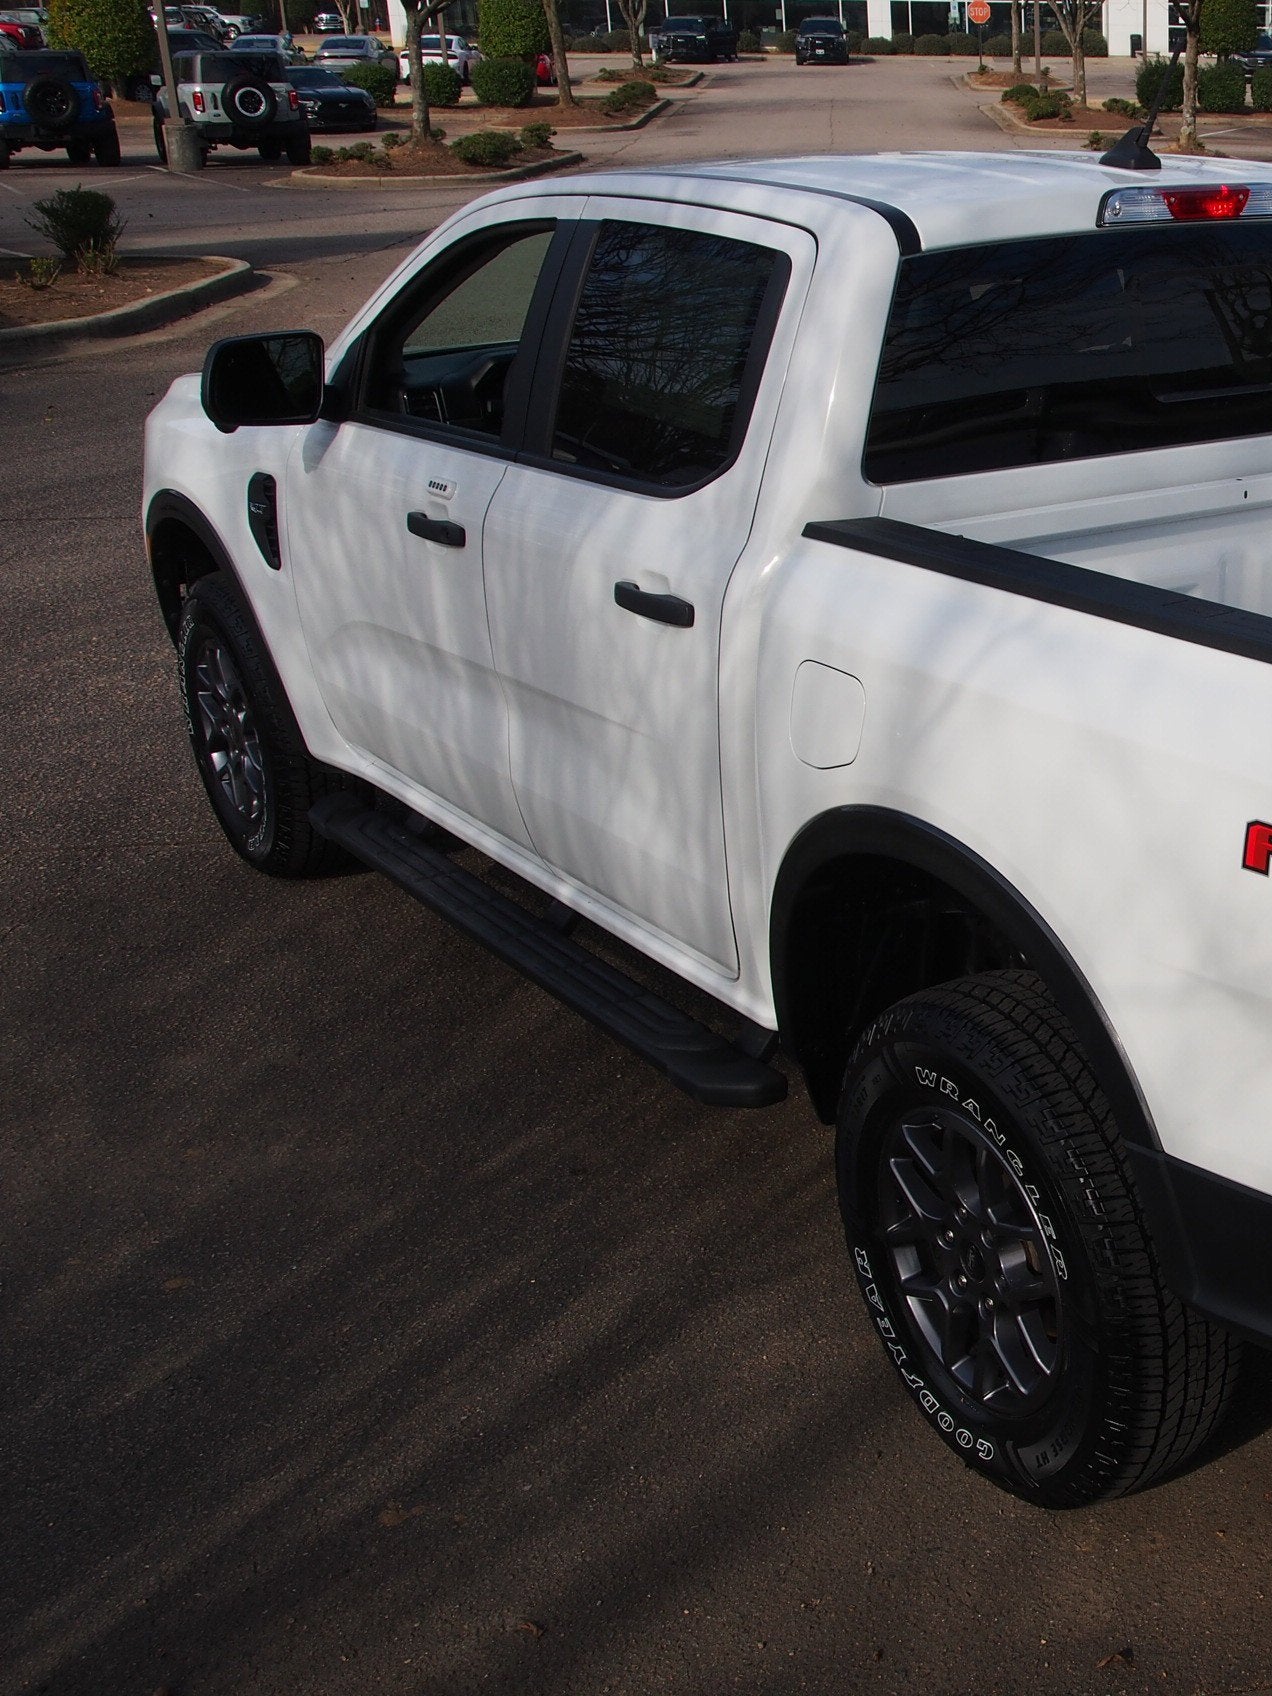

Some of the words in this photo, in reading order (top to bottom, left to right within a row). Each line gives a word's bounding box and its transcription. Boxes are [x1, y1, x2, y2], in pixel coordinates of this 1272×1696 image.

[970, 7, 989, 16] STOP
[914, 1065, 1069, 1282] WRANGLER
[854, 1246, 995, 1462] GOODYEAR
